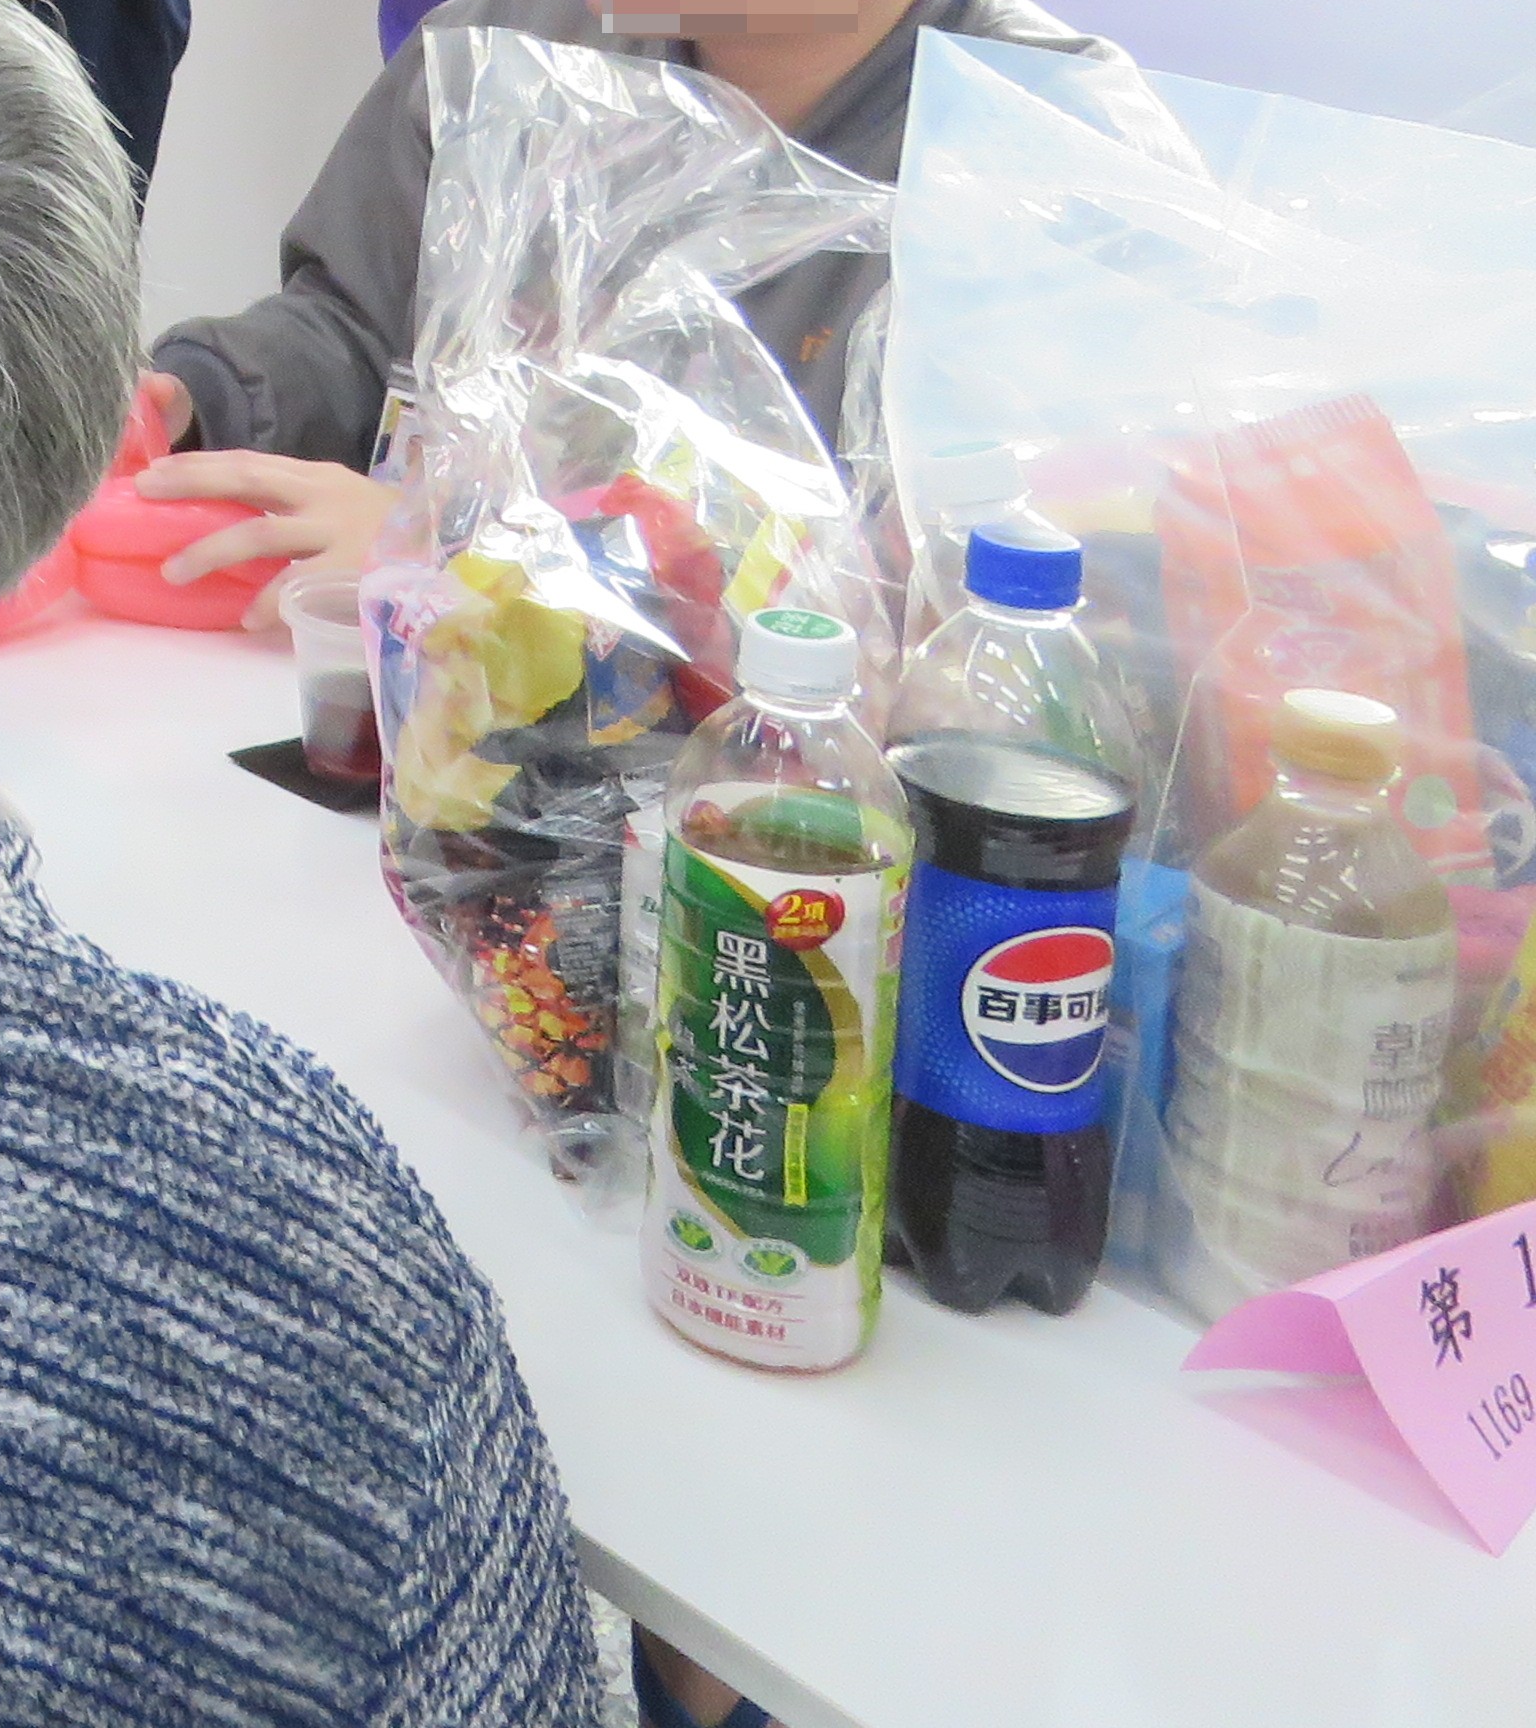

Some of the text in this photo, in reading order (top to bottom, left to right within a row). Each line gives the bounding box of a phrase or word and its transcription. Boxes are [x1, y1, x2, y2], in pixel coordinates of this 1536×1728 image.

[708, 929, 771, 1181] 黑松茶花
[1420, 1267, 1473, 1369] 第
